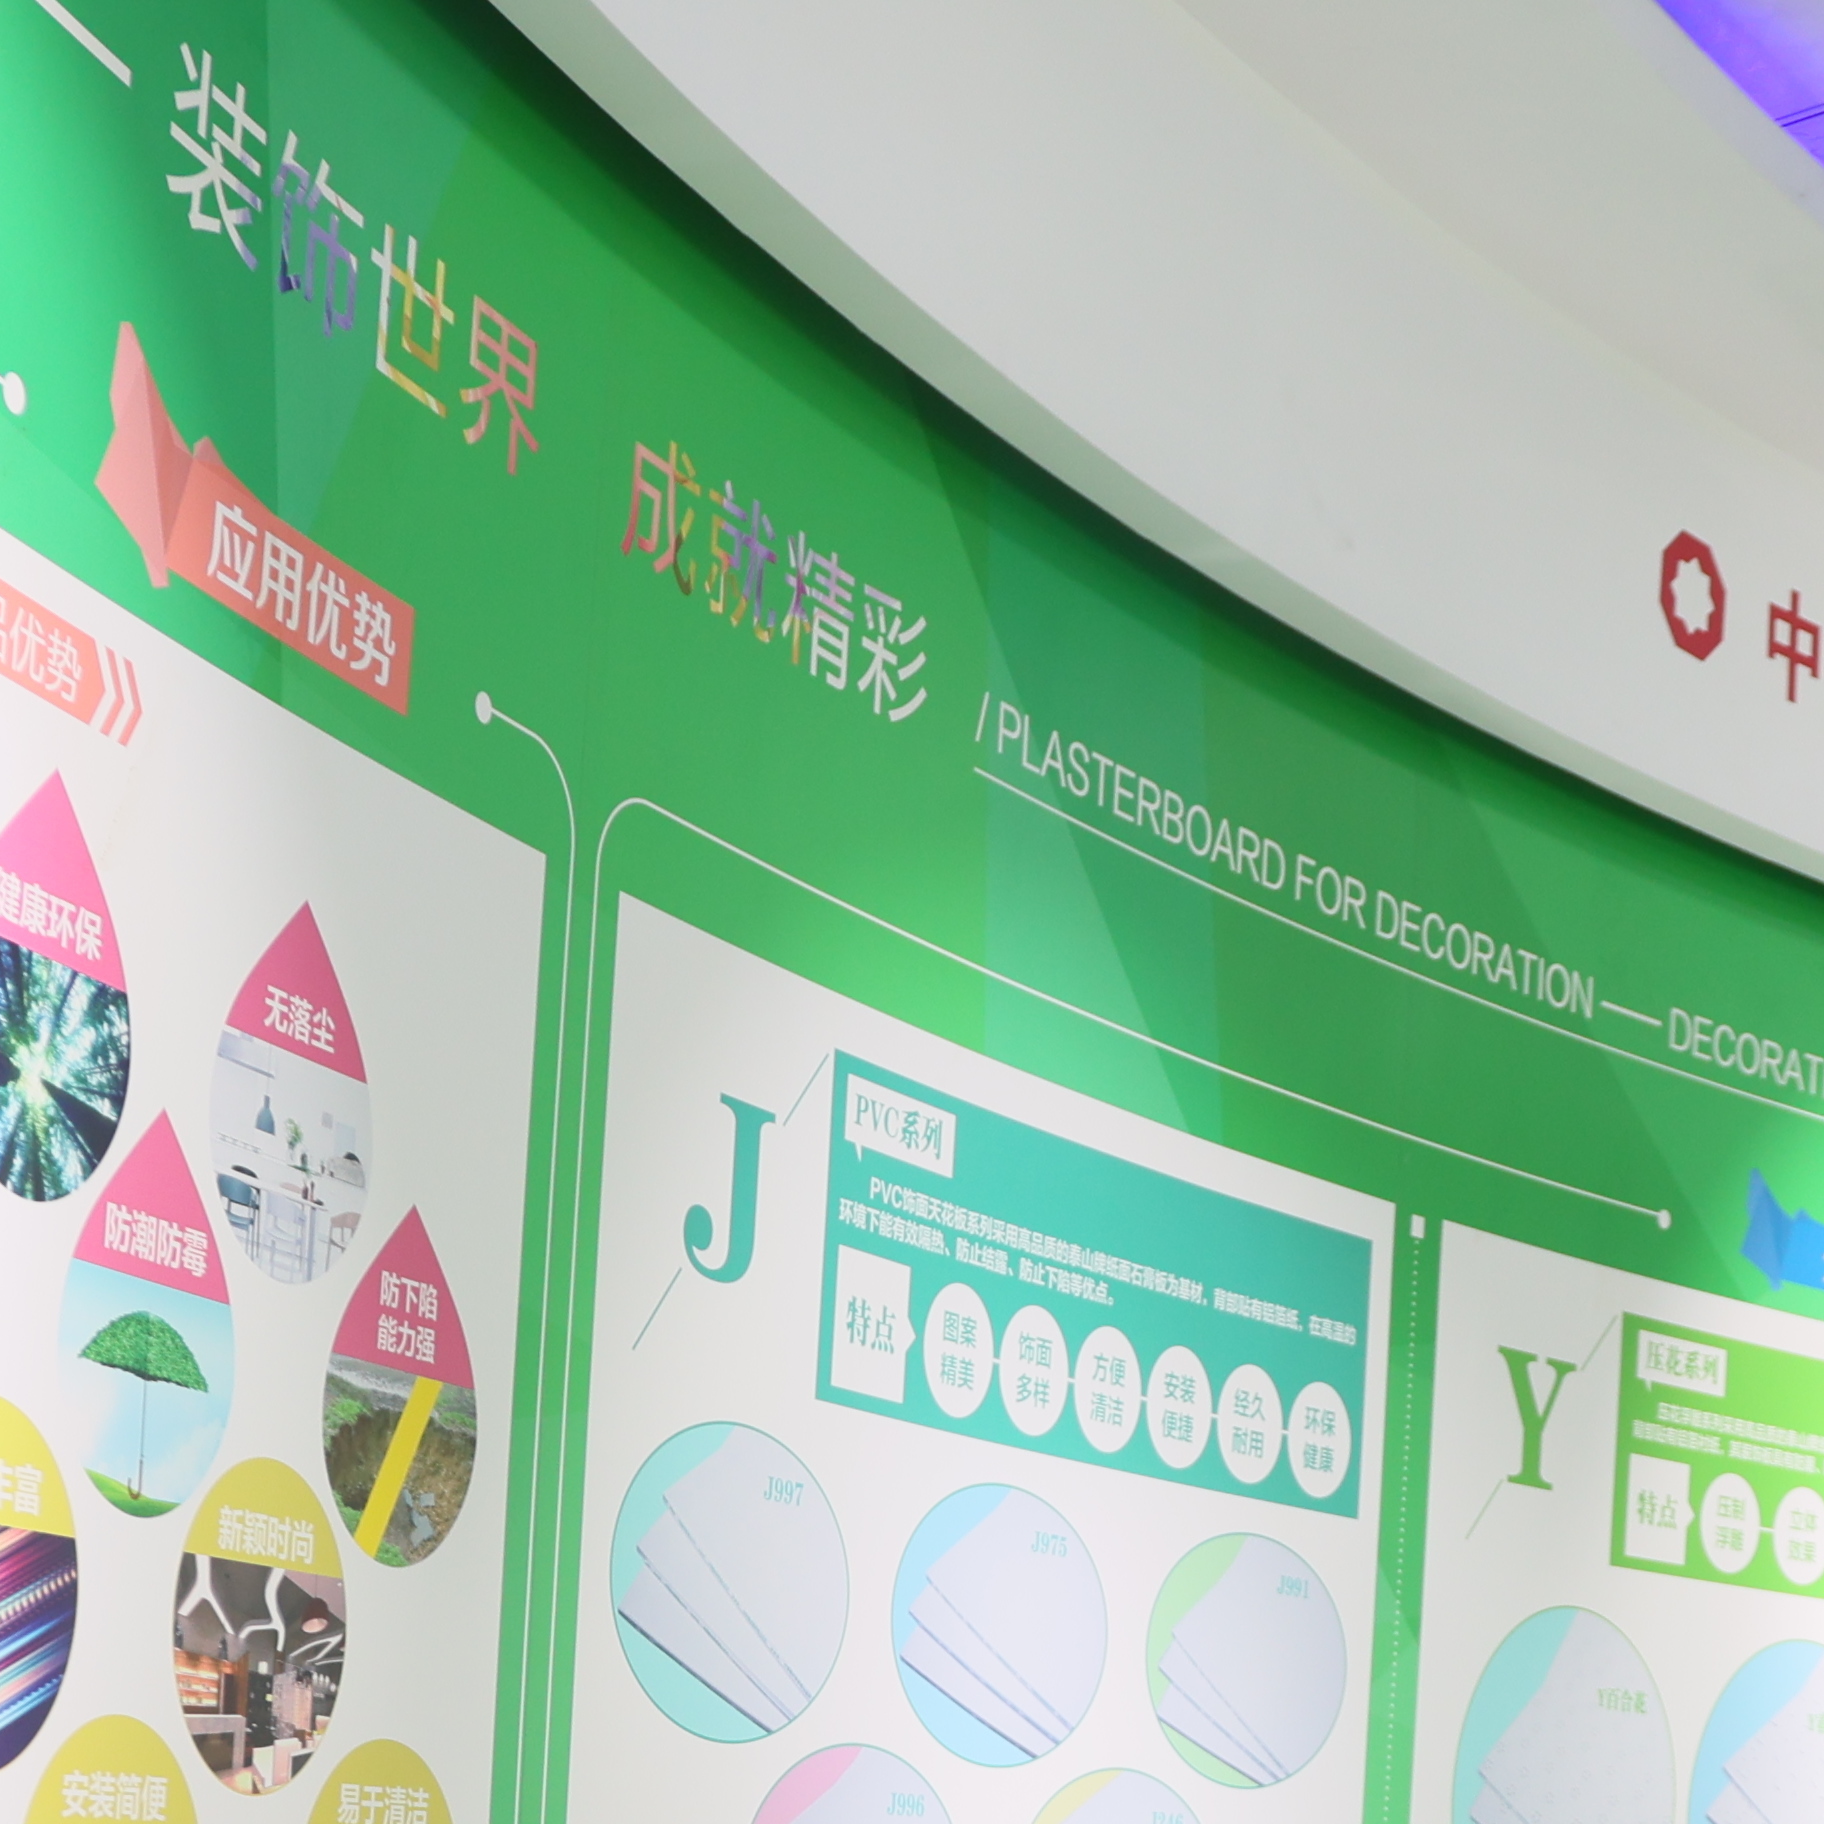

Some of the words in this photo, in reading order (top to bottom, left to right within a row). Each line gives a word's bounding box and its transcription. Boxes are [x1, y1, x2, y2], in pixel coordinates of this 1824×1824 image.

[166, 41, 540, 476] 装饰世界
[620, 440, 928, 722] 成就精彩
[207, 500, 396, 687] 应用优势
[997, 700, 1287, 890] PLASTERBOARD
[1294, 853, 1367, 929] FOR
[1376, 889, 1595, 1018] DECORATION
[264, 984, 335, 1054] 无落尘
[853, 1092, 943, 1160] PVC系列
[682, 1091, 777, 1284] J
[103, 1201, 208, 1279] 防潮防霉
[379, 1270, 439, 1322] 防下陷
[376, 1314, 436, 1365] 能力强
[845, 1295, 897, 1355] 特点
[942, 1310, 978, 1349] 图案
[1018, 1330, 1054, 1369] 饰面
[939, 1351, 975, 1391] 精美
[1091, 1353, 1127, 1388] 方便
[1162, 1370, 1196, 1404] 安装
[1015, 1372, 1051, 1410] 多样
[1089, 1391, 1125, 1428] 清洁
[1233, 1387, 1266, 1422] 经久
[1160, 1409, 1194, 1444] 便捷
[1304, 1405, 1336, 1438] 环保
[1496, 1344, 1578, 1491] Y
[1231, 1426, 1265, 1459] 耐用
[1302, 1441, 1335, 1474] 健康
[762, 1475, 805, 1508] J997
[1637, 1488, 1679, 1530] 特点
[217, 1505, 314, 1566] 新颖时尚
[1030, 1531, 1069, 1559] J975
[1276, 1573, 1311, 1600] J991
[61, 1770, 167, 1823] 安装简便
[886, 1791, 926, 1817] J996
